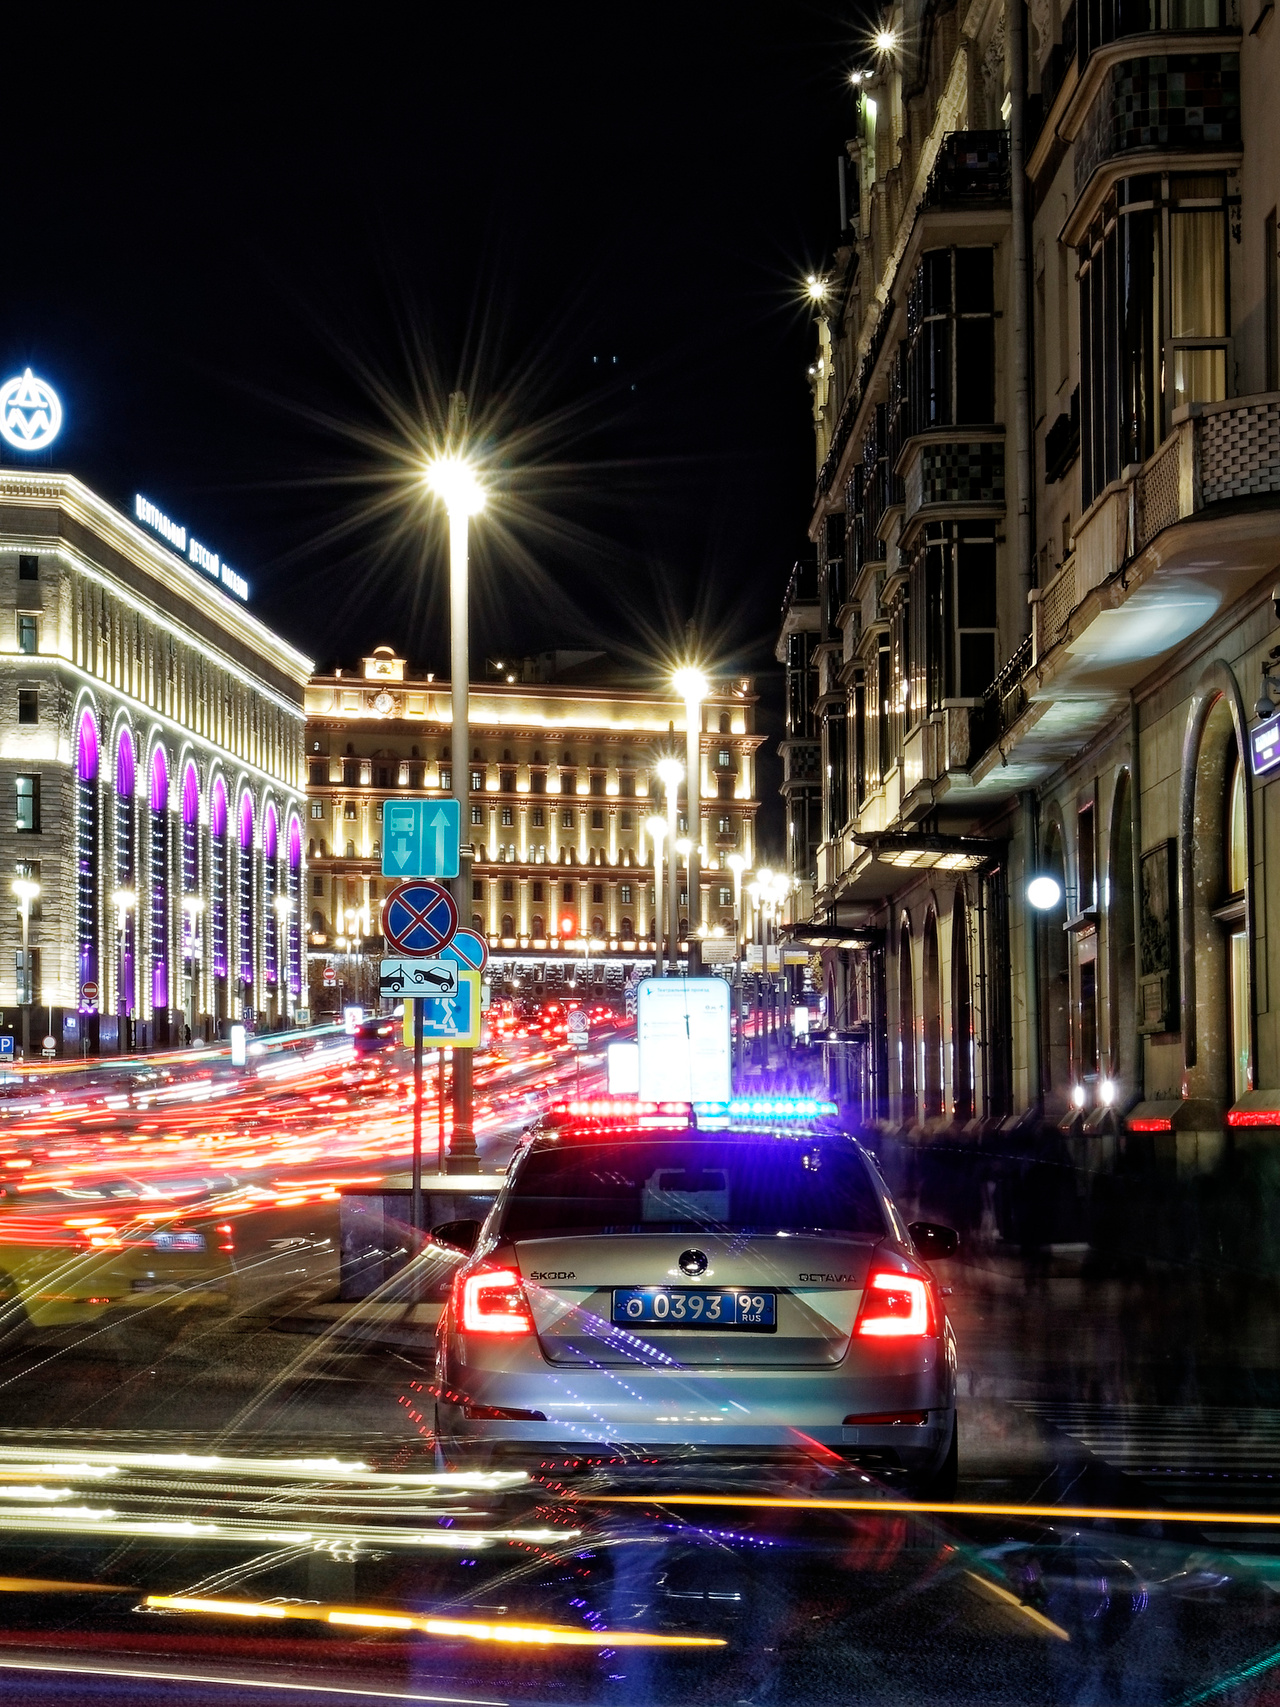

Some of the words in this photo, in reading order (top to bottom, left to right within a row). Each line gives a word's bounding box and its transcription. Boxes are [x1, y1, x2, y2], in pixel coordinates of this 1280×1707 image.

[530, 1271, 577, 1280] ŠKODA
[799, 1273, 857, 1283] OCTAVIA
[653, 1294, 722, 1320] 0393
[738, 1295, 765, 1314] 99
[742, 1314, 762, 1322] RUS
